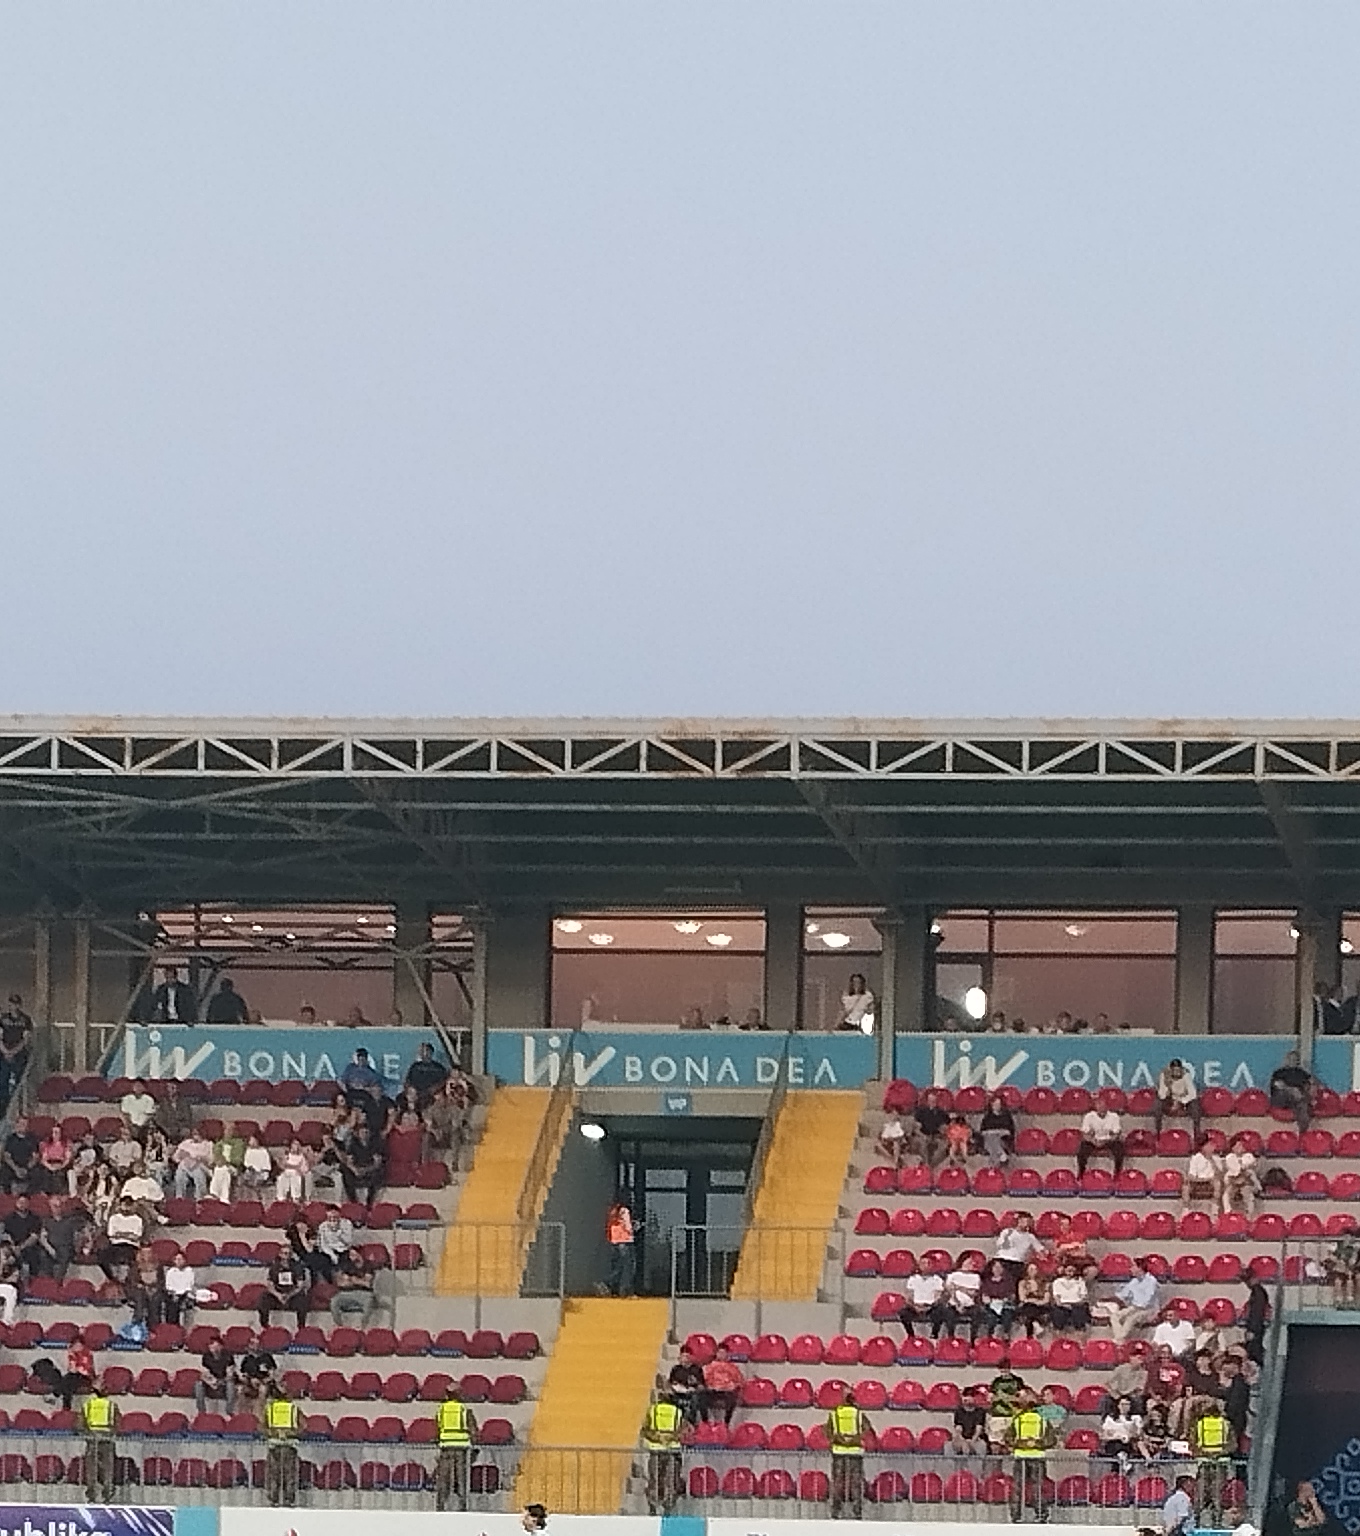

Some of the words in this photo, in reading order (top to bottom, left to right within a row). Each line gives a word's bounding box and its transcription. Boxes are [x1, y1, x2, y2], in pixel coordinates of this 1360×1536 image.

[223, 1050, 338, 1078] BONA
[624, 1055, 740, 1084] BONA
[756, 1056, 837, 1084] DEA
[1036, 1059, 1156, 1087] BONA
